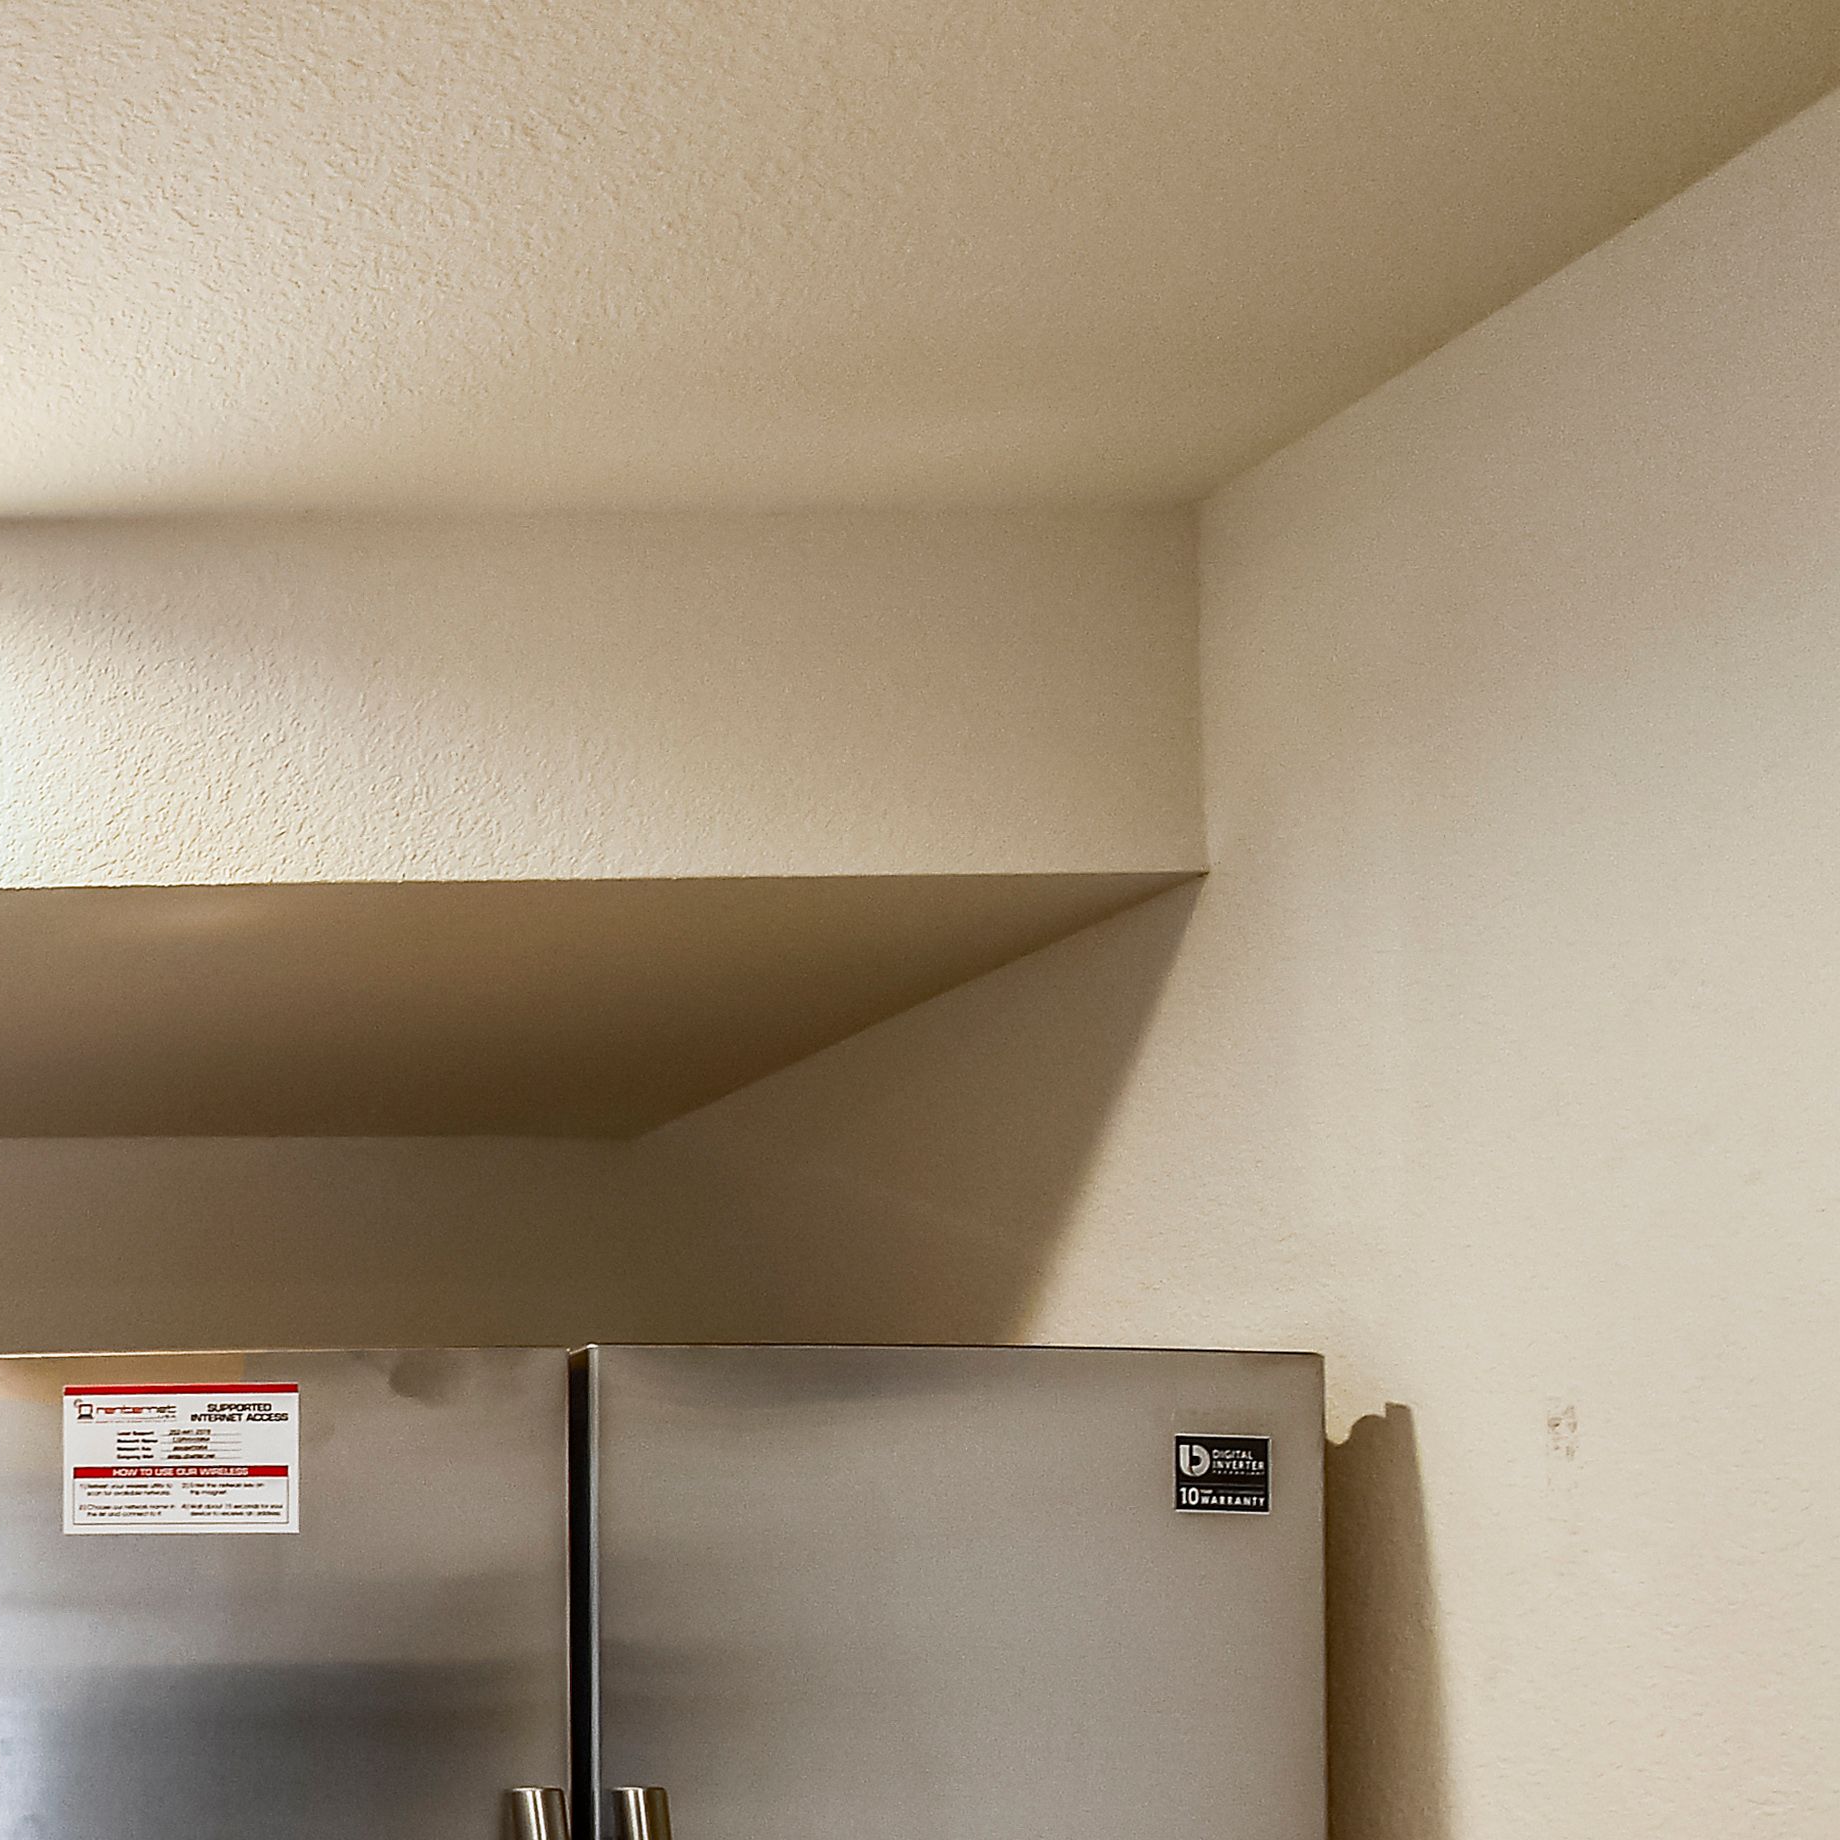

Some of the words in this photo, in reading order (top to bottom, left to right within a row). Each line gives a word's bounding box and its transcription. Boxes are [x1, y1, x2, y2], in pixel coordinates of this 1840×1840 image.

[207, 1403, 272, 1412] SUPPORTED
[191, 1413, 243, 1422] INTERNET
[247, 1412, 288, 1422] ACCESS
[1212, 1449, 1253, 1460] DIGITAL
[1212, 1460, 1265, 1471] INVERTER
[112, 1468, 138, 1476] HOW
[140, 1468, 153, 1476] TO
[154, 1467, 174, 1476] USE
[176, 1467, 197, 1476] OUR
[199, 1467, 248, 1475] WIRELESS
[1179, 1487, 1199, 1505] 10
[1201, 1495, 1265, 1506] WARRANTY
